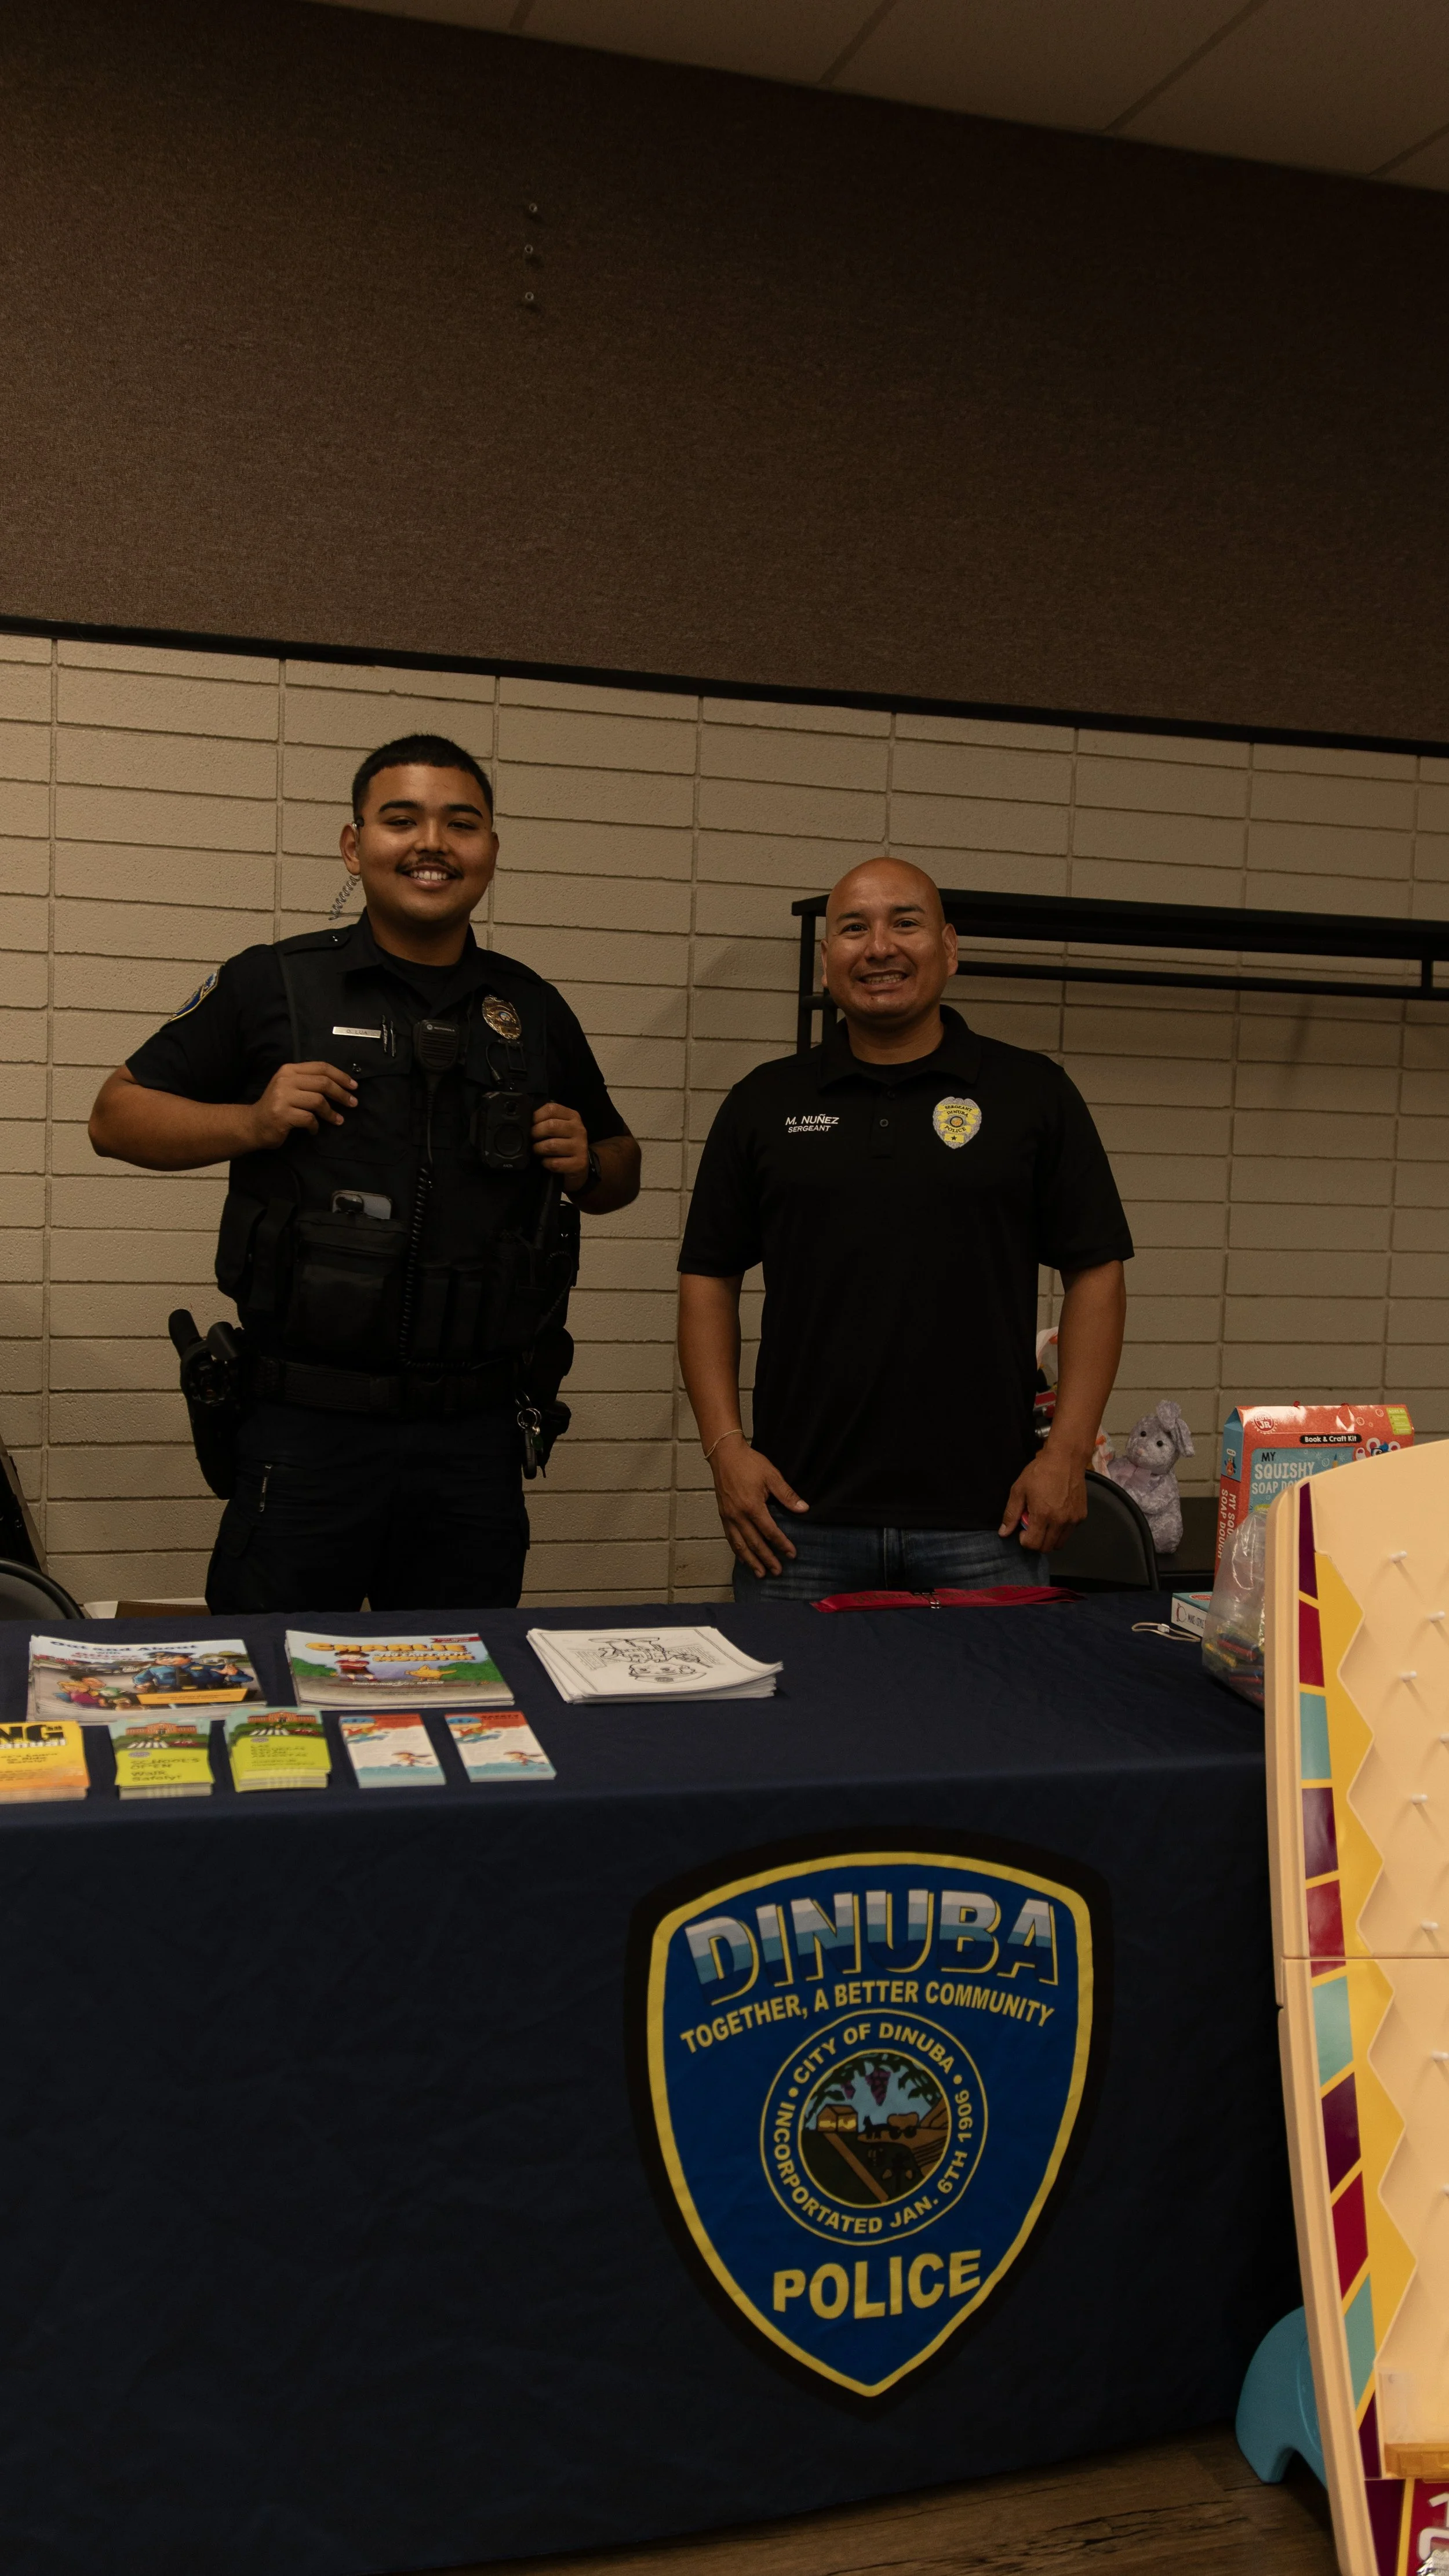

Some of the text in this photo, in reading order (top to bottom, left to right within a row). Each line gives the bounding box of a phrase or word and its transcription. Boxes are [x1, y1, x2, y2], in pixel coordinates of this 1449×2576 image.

[785, 1113, 840, 1126] M. NUÑEZ
[788, 1125, 831, 1133] SERGEANT
[944, 1125, 967, 1133] POLICE
[1259, 1420, 1272, 1429] JR
[1261, 1451, 1276, 1462] MY
[1254, 1462, 1315, 1479] SQUISHY
[1252, 1481, 1279, 1495] SOAP
[1228, 1493, 1236, 1511] MY
[1217, 1488, 1228, 1559] SOAP DOUGH
[50, 1641, 87, 1649] Out
[305, 1642, 468, 1652] CHARLIE
[684, 1888, 1060, 2006] DINUBA
[679, 1979, 1055, 2054] TOGETHER, A BETTER COMMUNITY
[792, 2022, 956, 2084] CITY OF DINUBA
[773, 2088, 974, 2235] INCORPORTATED JAN. 6TH 1906
[773, 2248, 982, 2320] POLICE
